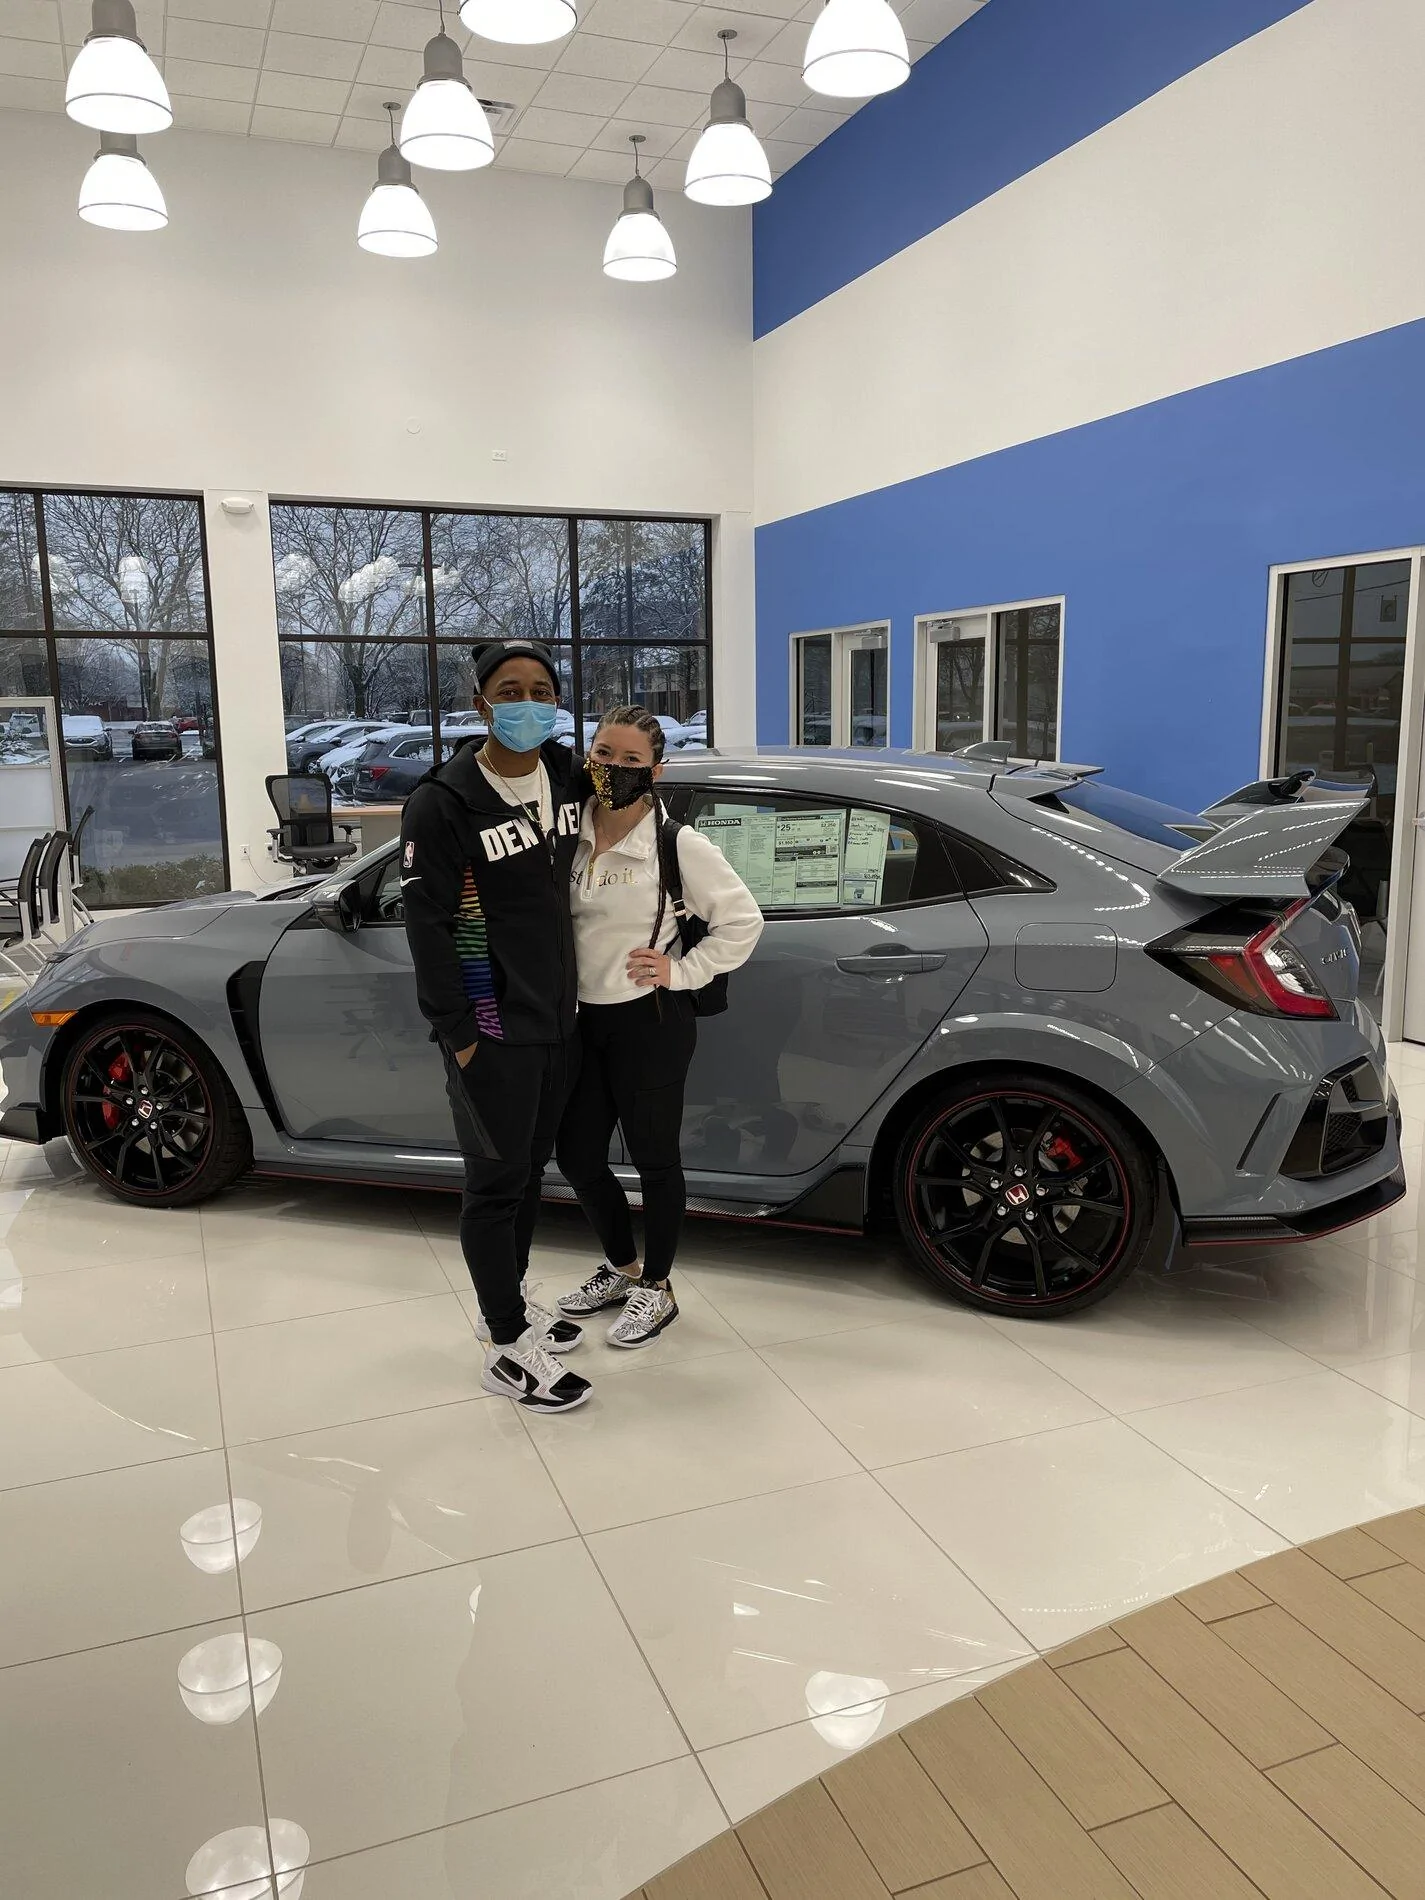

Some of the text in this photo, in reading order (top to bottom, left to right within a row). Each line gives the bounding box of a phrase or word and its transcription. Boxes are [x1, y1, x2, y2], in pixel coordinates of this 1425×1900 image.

[707, 819, 741, 827] HONDA
[781, 823, 791, 831] 25
[479, 801, 581, 862] DENE
[597, 870, 618, 887] do
